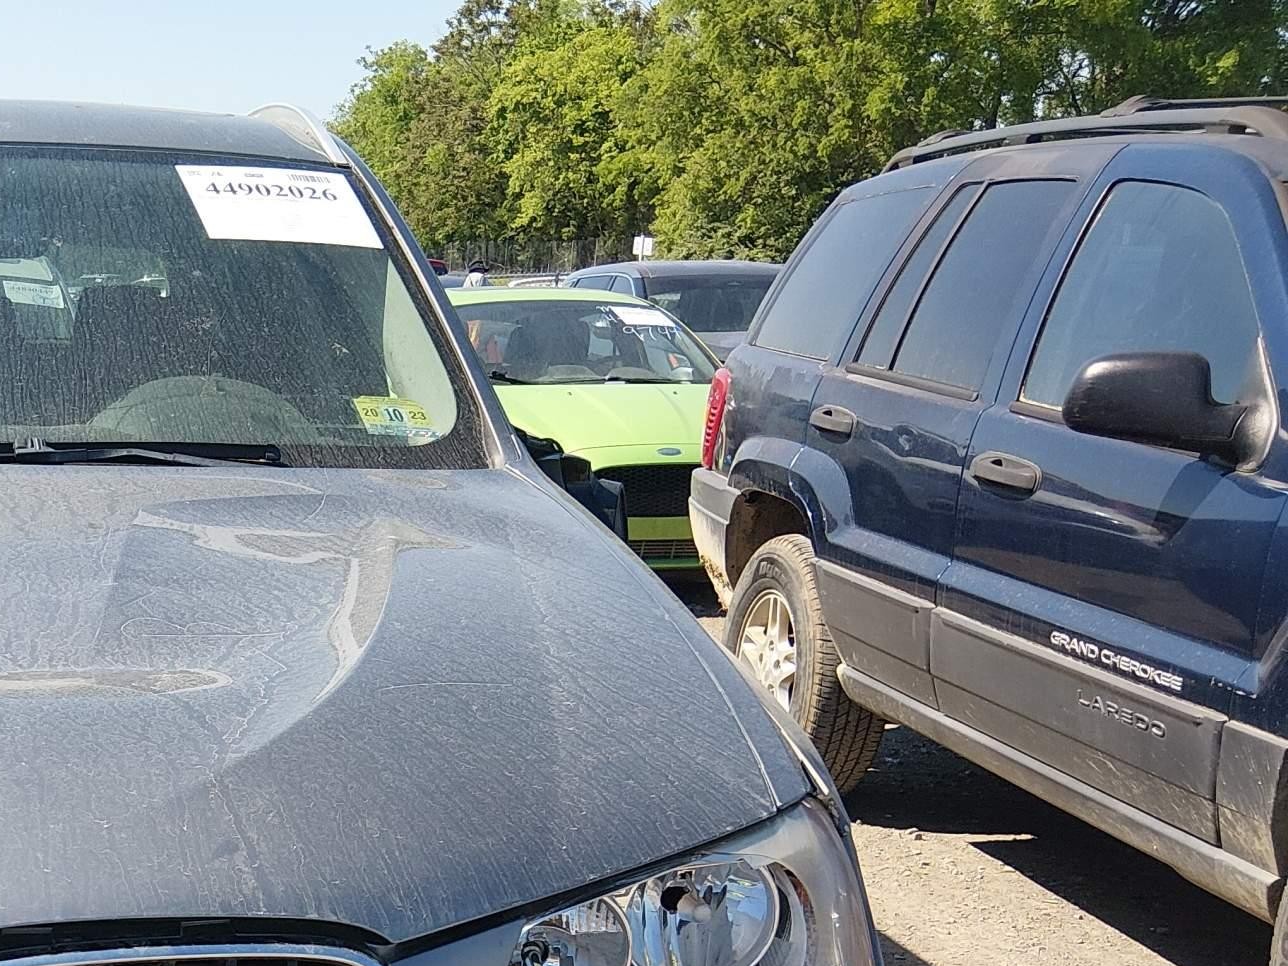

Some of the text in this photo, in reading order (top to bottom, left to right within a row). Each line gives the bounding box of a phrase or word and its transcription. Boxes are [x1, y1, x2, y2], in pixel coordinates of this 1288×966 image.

[206, 181, 338, 202] 44902026
[362, 407, 427, 423] 20 10 23
[1050, 631, 1184, 692] GRAND CHEROKEE
[1077, 688, 1168, 740] LAREDO
